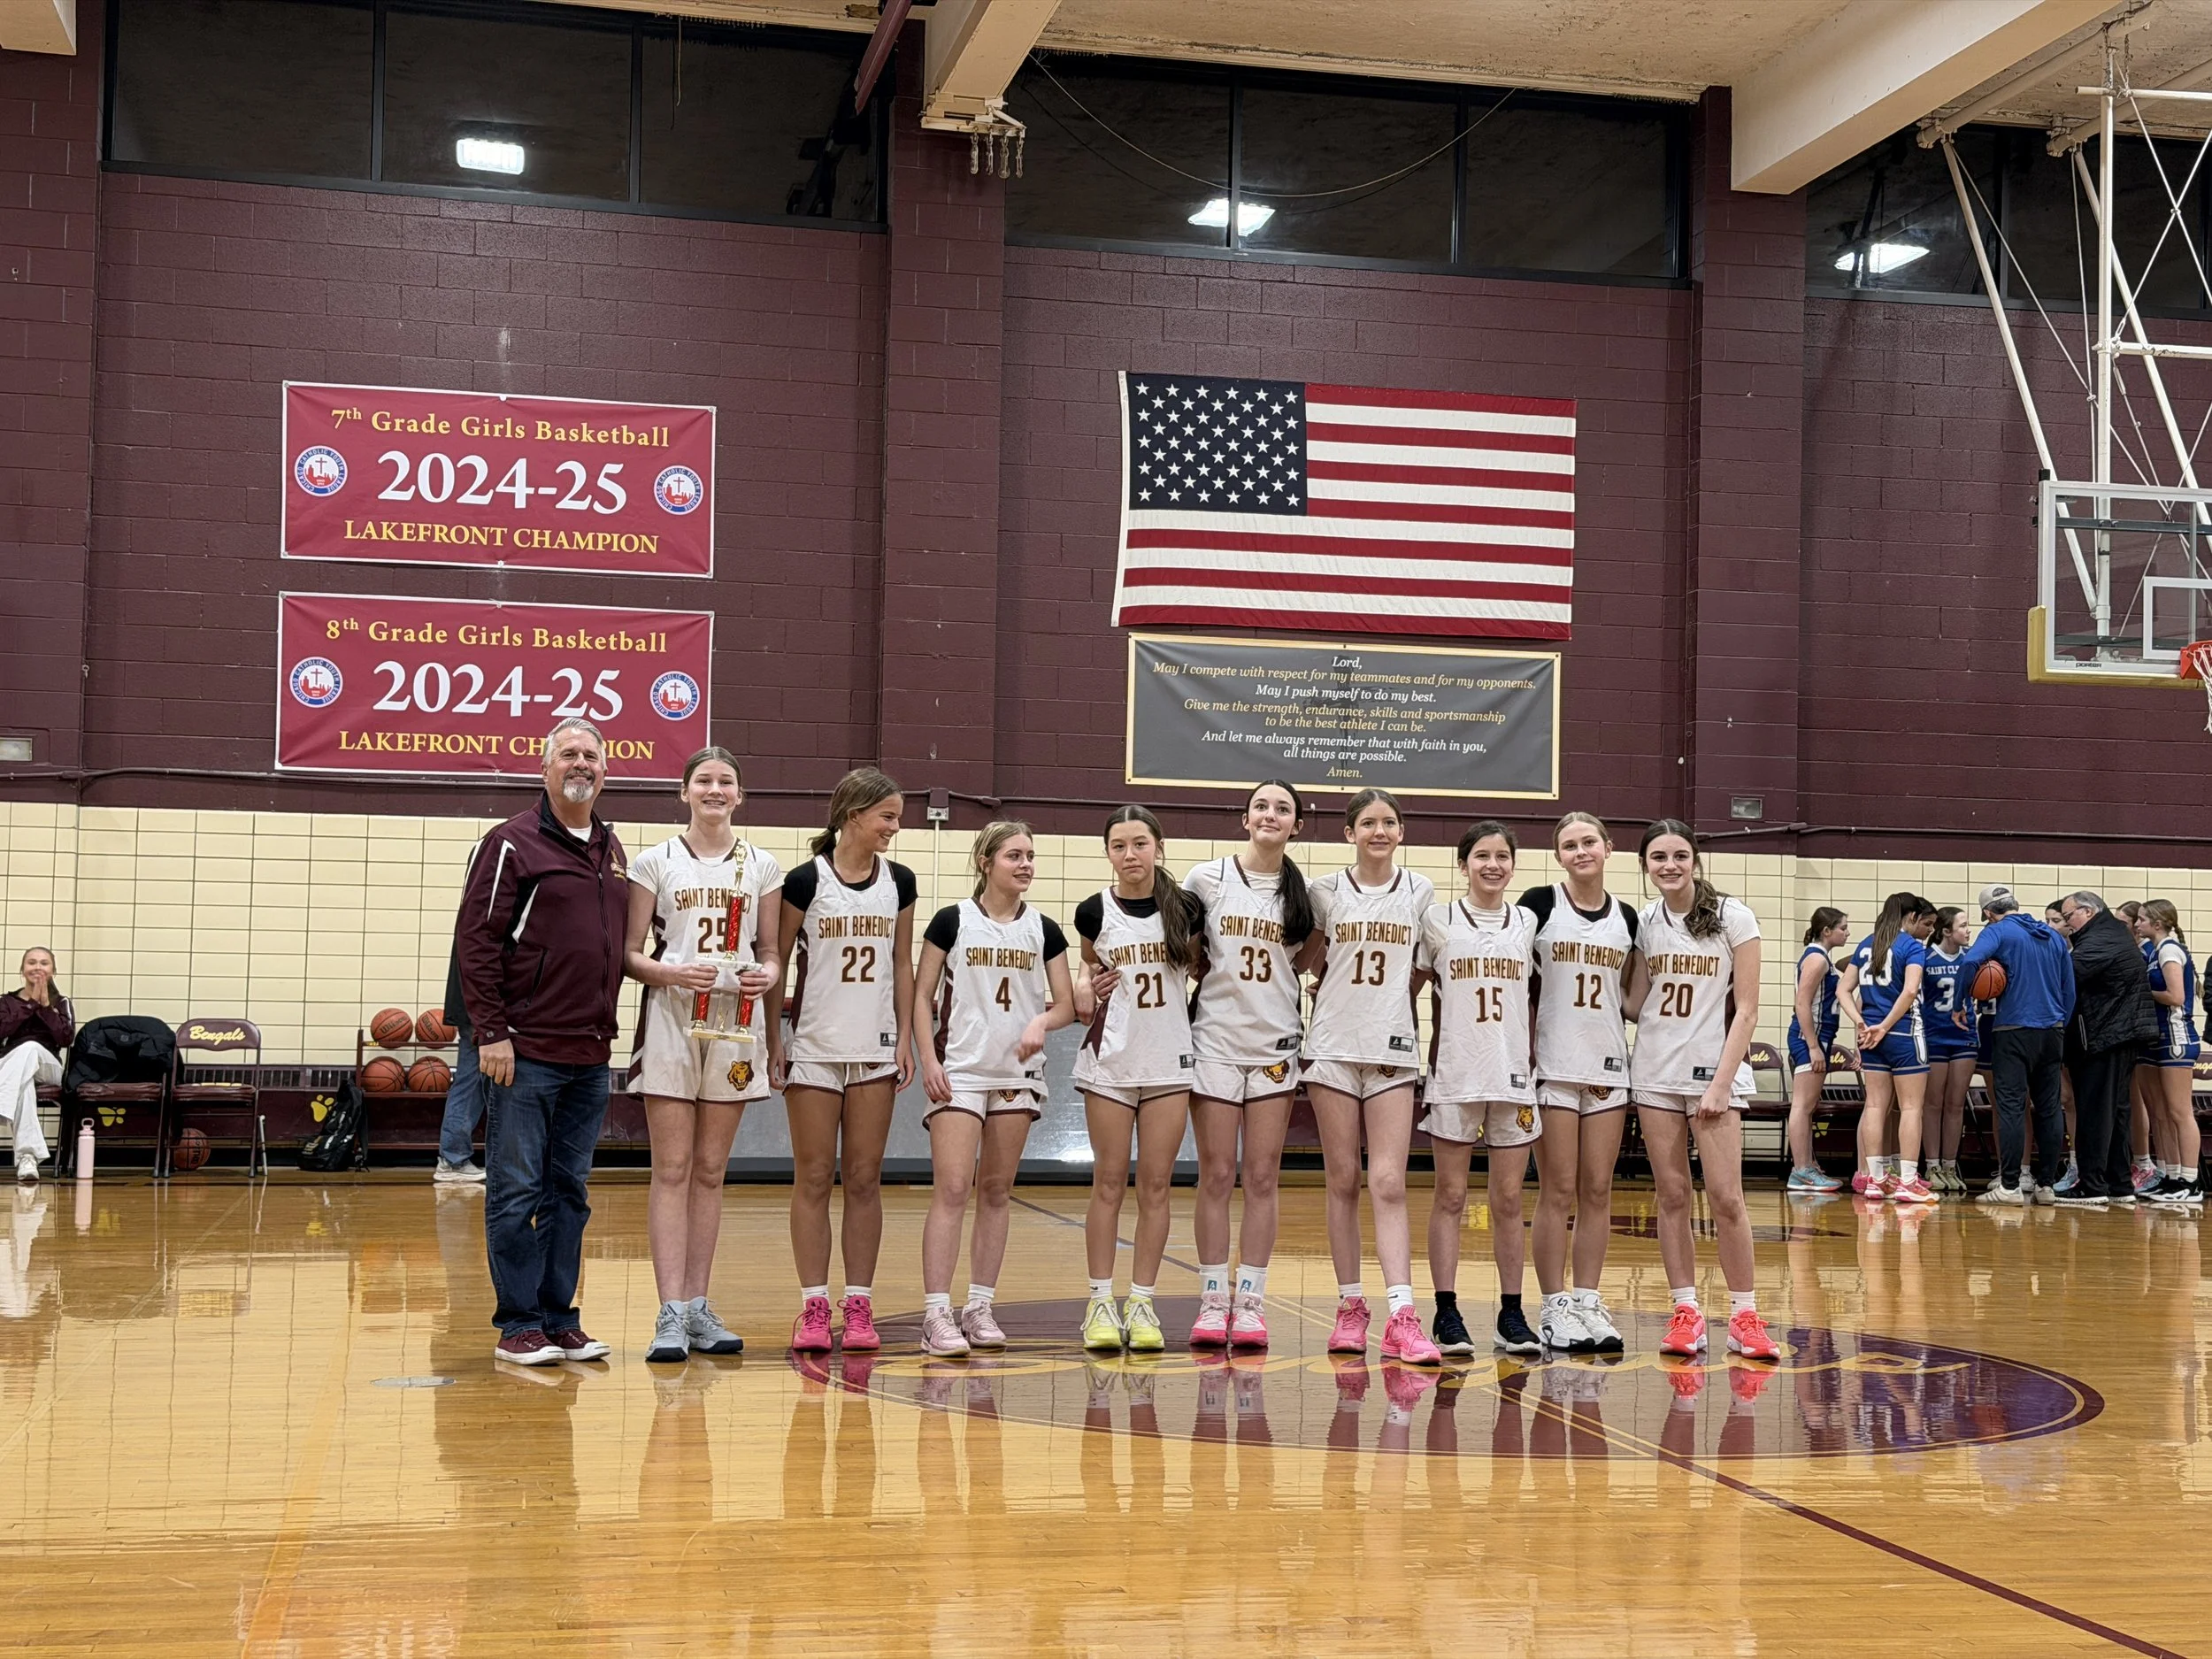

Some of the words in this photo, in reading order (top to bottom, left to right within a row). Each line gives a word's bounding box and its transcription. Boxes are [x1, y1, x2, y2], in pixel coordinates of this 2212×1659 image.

[330, 408, 363, 430] 7th
[371, 411, 451, 434] Grade
[460, 415, 526, 440] Girls
[535, 421, 670, 448] Basketball
[299, 449, 328, 465] CATHOLIC
[329, 452, 345, 470] YOUTH
[377, 449, 628, 515] 2024-25
[658, 468, 686, 484] CATHOLIC
[687, 472, 701, 489] YOUTH
[344, 518, 508, 549] LAKEFRONT
[512, 526, 659, 555] CHAMPION
[326, 618, 359, 641] 8th
[368, 620, 448, 644] Grade
[457, 625, 523, 648] Girls
[532, 631, 668, 653] Basketball
[295, 660, 324, 676] CATHOLIC
[326, 663, 340, 681] YOUTH
[1332, 656, 1363, 670] Lord,
[655, 674, 681, 689] CATHOLIC
[683, 676, 697, 695] YOUTH
[1153, 662, 1179, 676] May
[1182, 664, 1188, 674] I
[1190, 666, 1237, 678] compete
[1240, 666, 1265, 678] with
[1268, 670, 1308, 680] respect
[1308, 669, 1327, 682] for
[1330, 673, 1348, 683] my
[1350, 672, 1411, 684] teammates
[1413, 674, 1435, 686] and
[1435, 674, 1455, 687] for
[1456, 679, 1475, 688] my
[1477, 679, 1536, 691] opponents.
[373, 659, 624, 722] 2024-25
[1256, 684, 1282, 698] May
[1284, 686, 1290, 696] I
[1292, 687, 1318, 699] push
[1321, 687, 1360, 702] myself
[1361, 690, 1372, 699] to
[1374, 689, 1388, 700] do
[1391, 693, 1409, 703] my
[1411, 690, 1437, 703] best.
[1184, 698, 1210, 710] Give
[1212, 702, 1230, 710] me
[1233, 700, 1250, 711] the
[1252, 702, 1302, 717] strength,
[1305, 703, 1367, 718] endurance,
[1370, 707, 1398, 718] skills
[1400, 709, 1423, 719] and
[1424, 710, 1506, 724] sportsmanship
[1265, 717, 1277, 726] to
[1279, 716, 1293, 727] be
[1295, 717, 1311, 727] the
[1315, 717, 1337, 729] best
[1339, 718, 1378, 731] athlete
[1380, 720, 1386, 731] I
[1387, 722, 1408, 732] can
[1410, 721, 1426, 733] be.
[339, 730, 503, 757] LAKEFRONT
[509, 736, 656, 760] CHION
[1201, 731, 1228, 742] And
[1229, 731, 1243, 742] let
[1245, 734, 1263, 743] me
[1264, 733, 1305, 747] always
[1308, 735, 1365, 748] remember
[1368, 737, 1391, 749] that
[1393, 739, 1417, 749] with
[1418, 739, 1447, 752] faith
[1449, 740, 1460, 751] in
[1462, 742, 1486, 754] you,
[1283, 747, 1298, 758] all
[1301, 747, 1335, 762] things
[1338, 750, 1357, 760] are
[1358, 750, 1407, 763] possible.
[1326, 766, 1363, 778] Amen.
[674, 887, 704, 911] SAINT
[818, 916, 848, 939] SAINT
[852, 916, 894, 940] BENEDICT
[1220, 915, 1249, 937] SAINT
[1252, 918, 1283, 944] BENED
[1335, 922, 1364, 943] SAINT
[1366, 921, 1412, 946] BENEDICT
[841, 946, 875, 983] 22
[966, 947, 994, 967] SAINT
[996, 948, 1037, 972] BENEDICT
[1109, 944, 1136, 968] SAINT
[1140, 941, 1166, 964] BENE
[1240, 946, 1271, 983] 33
[1351, 949, 1386, 986] 13
[1552, 941, 1581, 963] SAINT
[1585, 944, 1624, 971] BENEDICT
[1647, 954, 1669, 977] SAINT
[1672, 954, 1720, 978] BENEDICT
[1449, 957, 1479, 980] SAINT
[1483, 957, 1523, 982] BENEDICT
[1926, 965, 1947, 975] SAINT
[995, 976, 1012, 1012] 4
[1134, 972, 1166, 1009] 21
[1573, 972, 1601, 1010] 12
[1659, 982, 1694, 1018] 20
[1934, 977, 1955, 1011] 3
[1475, 987, 1503, 1023] 15
[189, 1025, 246, 1045] Bengals
[379, 1016, 407, 1034] Wilson
[421, 1015, 440, 1041] Wilson
